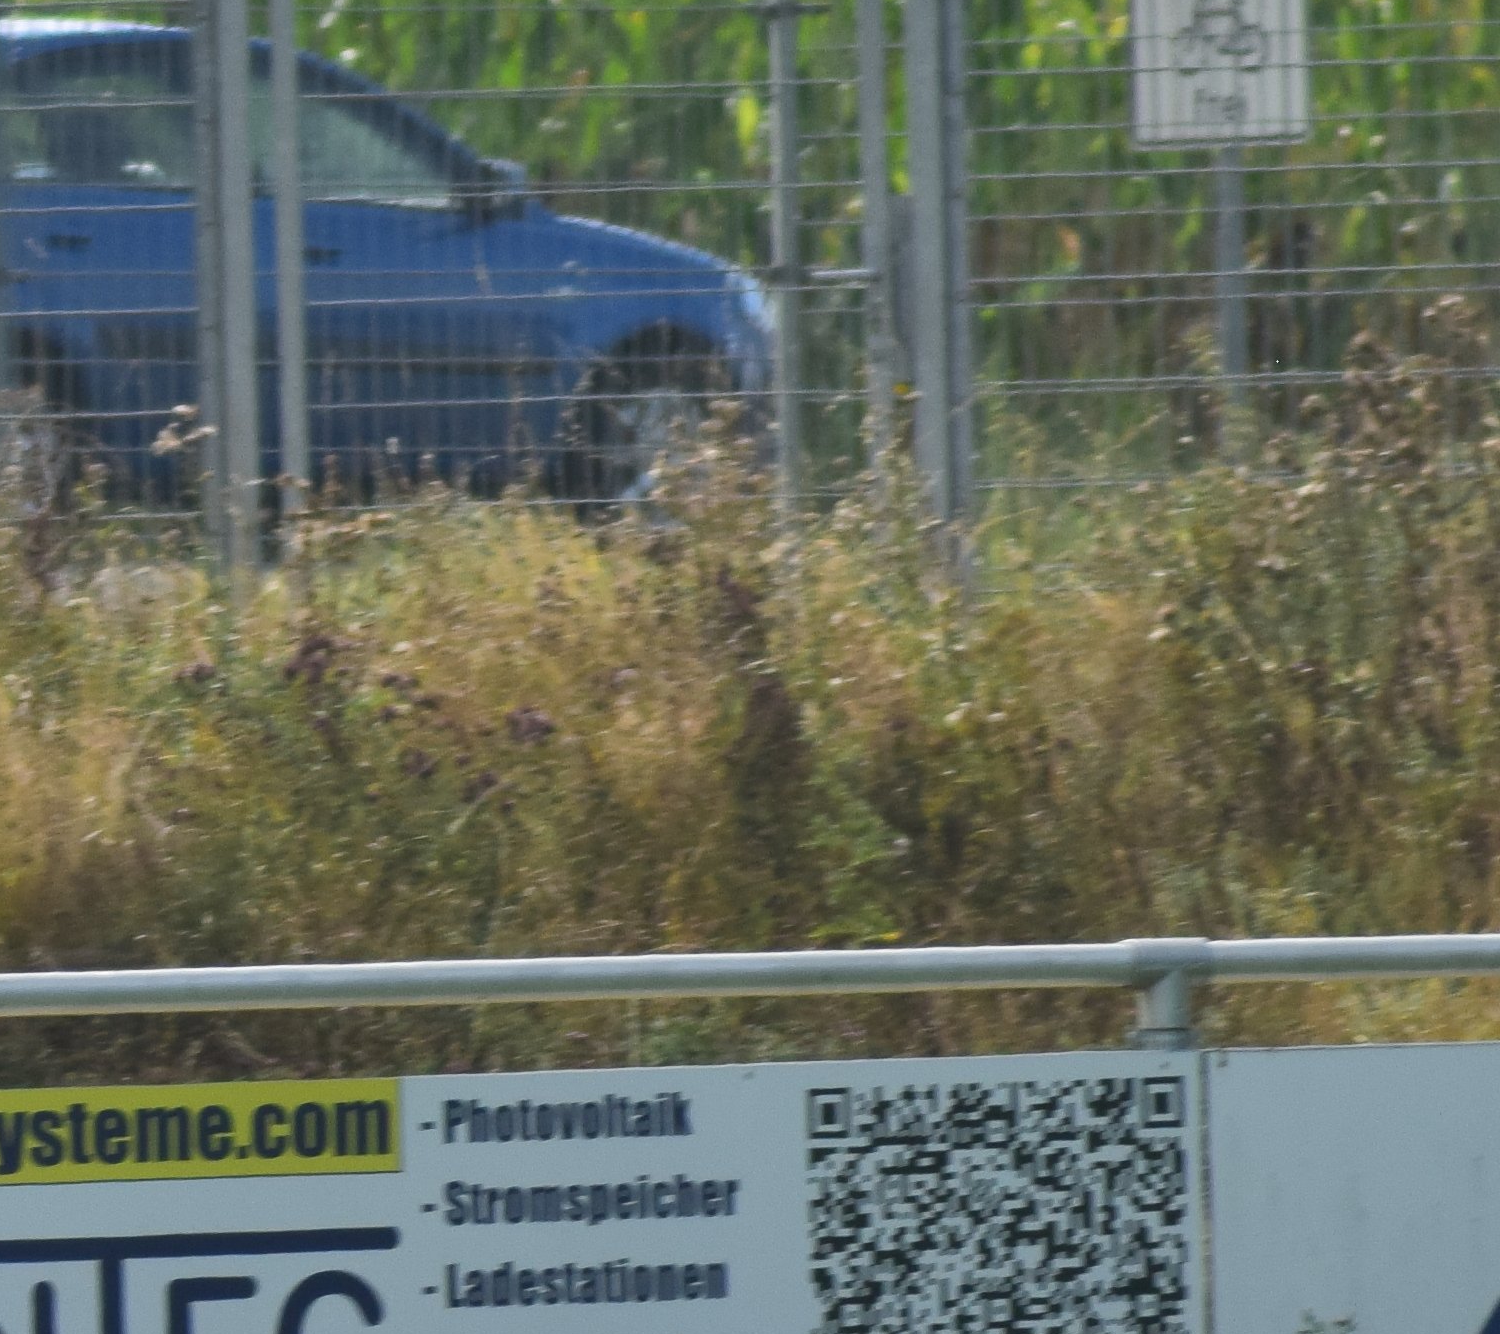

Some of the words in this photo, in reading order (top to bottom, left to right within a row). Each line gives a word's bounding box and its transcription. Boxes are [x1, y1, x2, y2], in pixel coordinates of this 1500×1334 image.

[444, 1091, 694, 1144] Photovoltaik
[444, 1174, 741, 1226] Stromspeicher
[445, 1259, 731, 1308] Ladestationen
